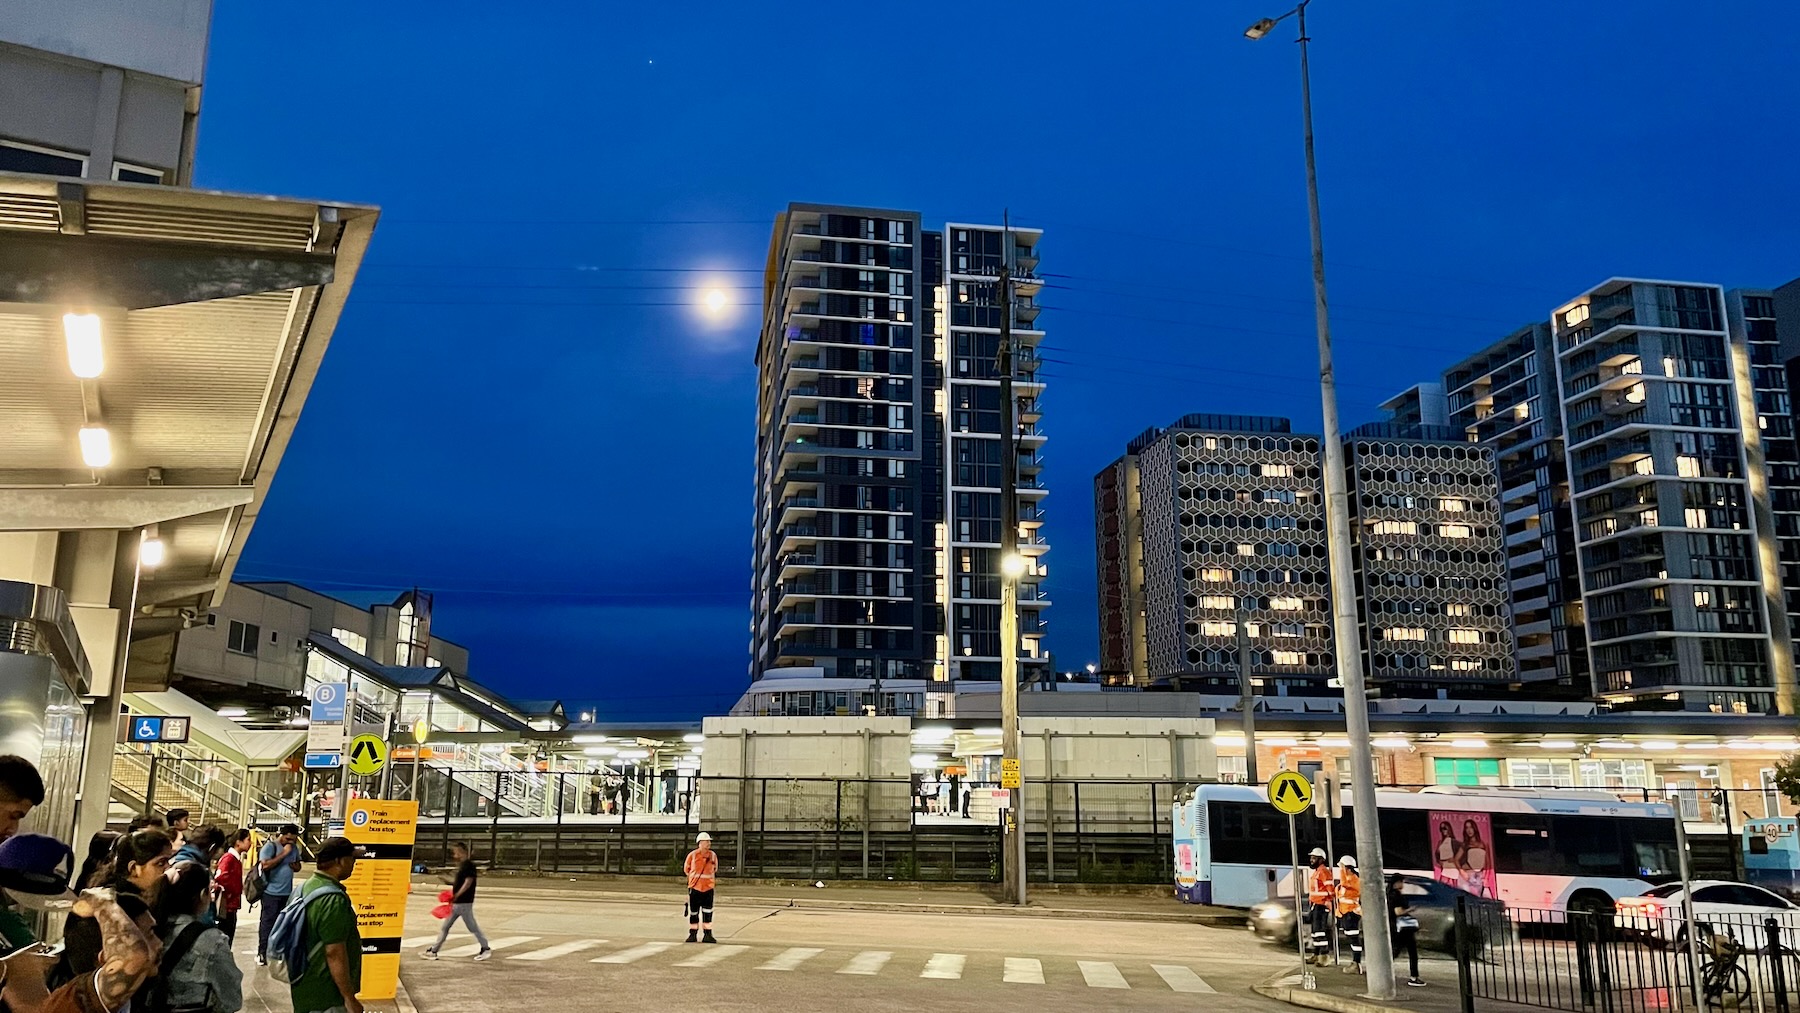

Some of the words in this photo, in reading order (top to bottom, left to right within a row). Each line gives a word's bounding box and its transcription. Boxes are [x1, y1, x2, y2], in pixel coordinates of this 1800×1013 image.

[321, 689, 330, 700] B
[330, 756, 337, 765] A
[356, 813, 364, 824] B
[1431, 813, 1464, 821] WHITE
[1467, 814, 1488, 823] FOX
[1767, 828, 1777, 838] 40
